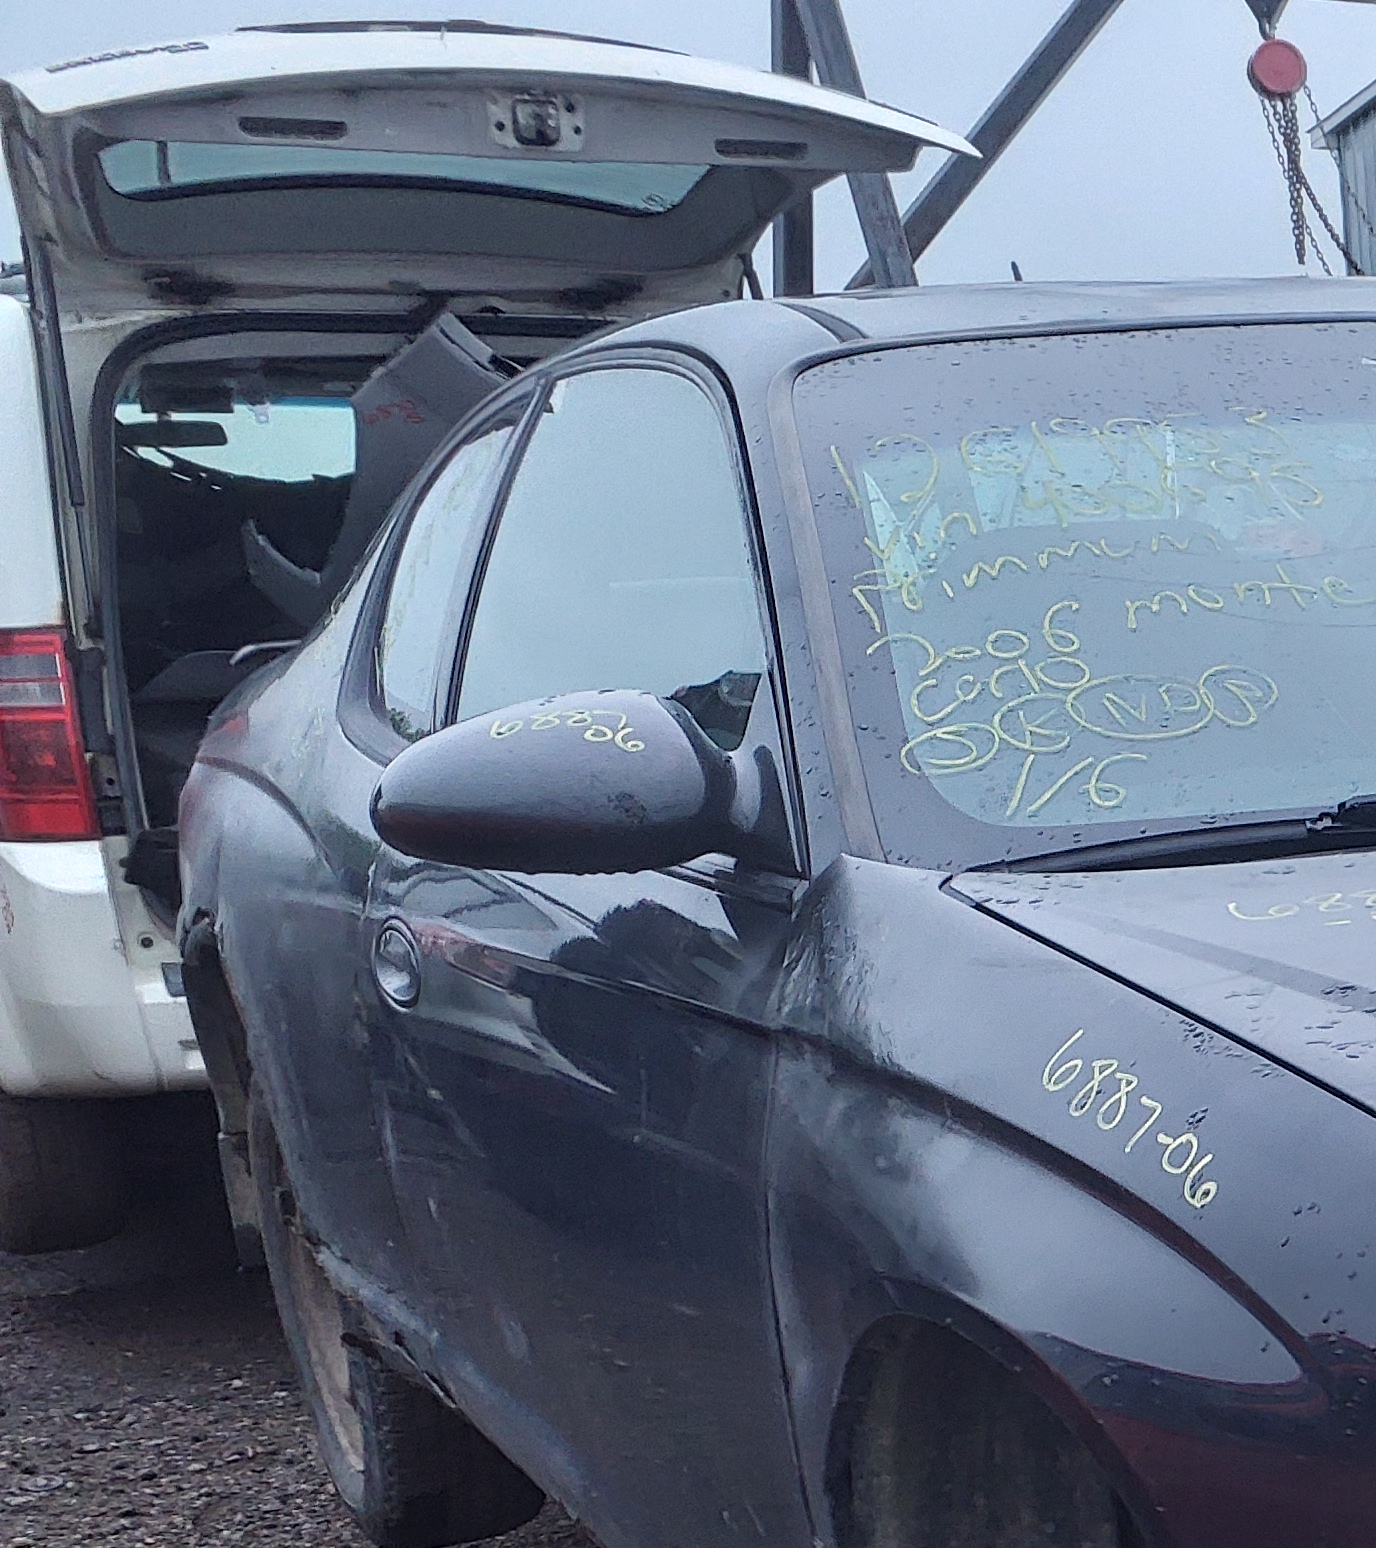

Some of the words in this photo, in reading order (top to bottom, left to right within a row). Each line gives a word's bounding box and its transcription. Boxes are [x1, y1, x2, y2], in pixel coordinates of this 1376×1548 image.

[866, 599, 1081, 676] 2006
[489, 709, 628, 740] 6887
[583, 724, 647, 753] 06
[1041, 1029, 1219, 1209] 6887-06
